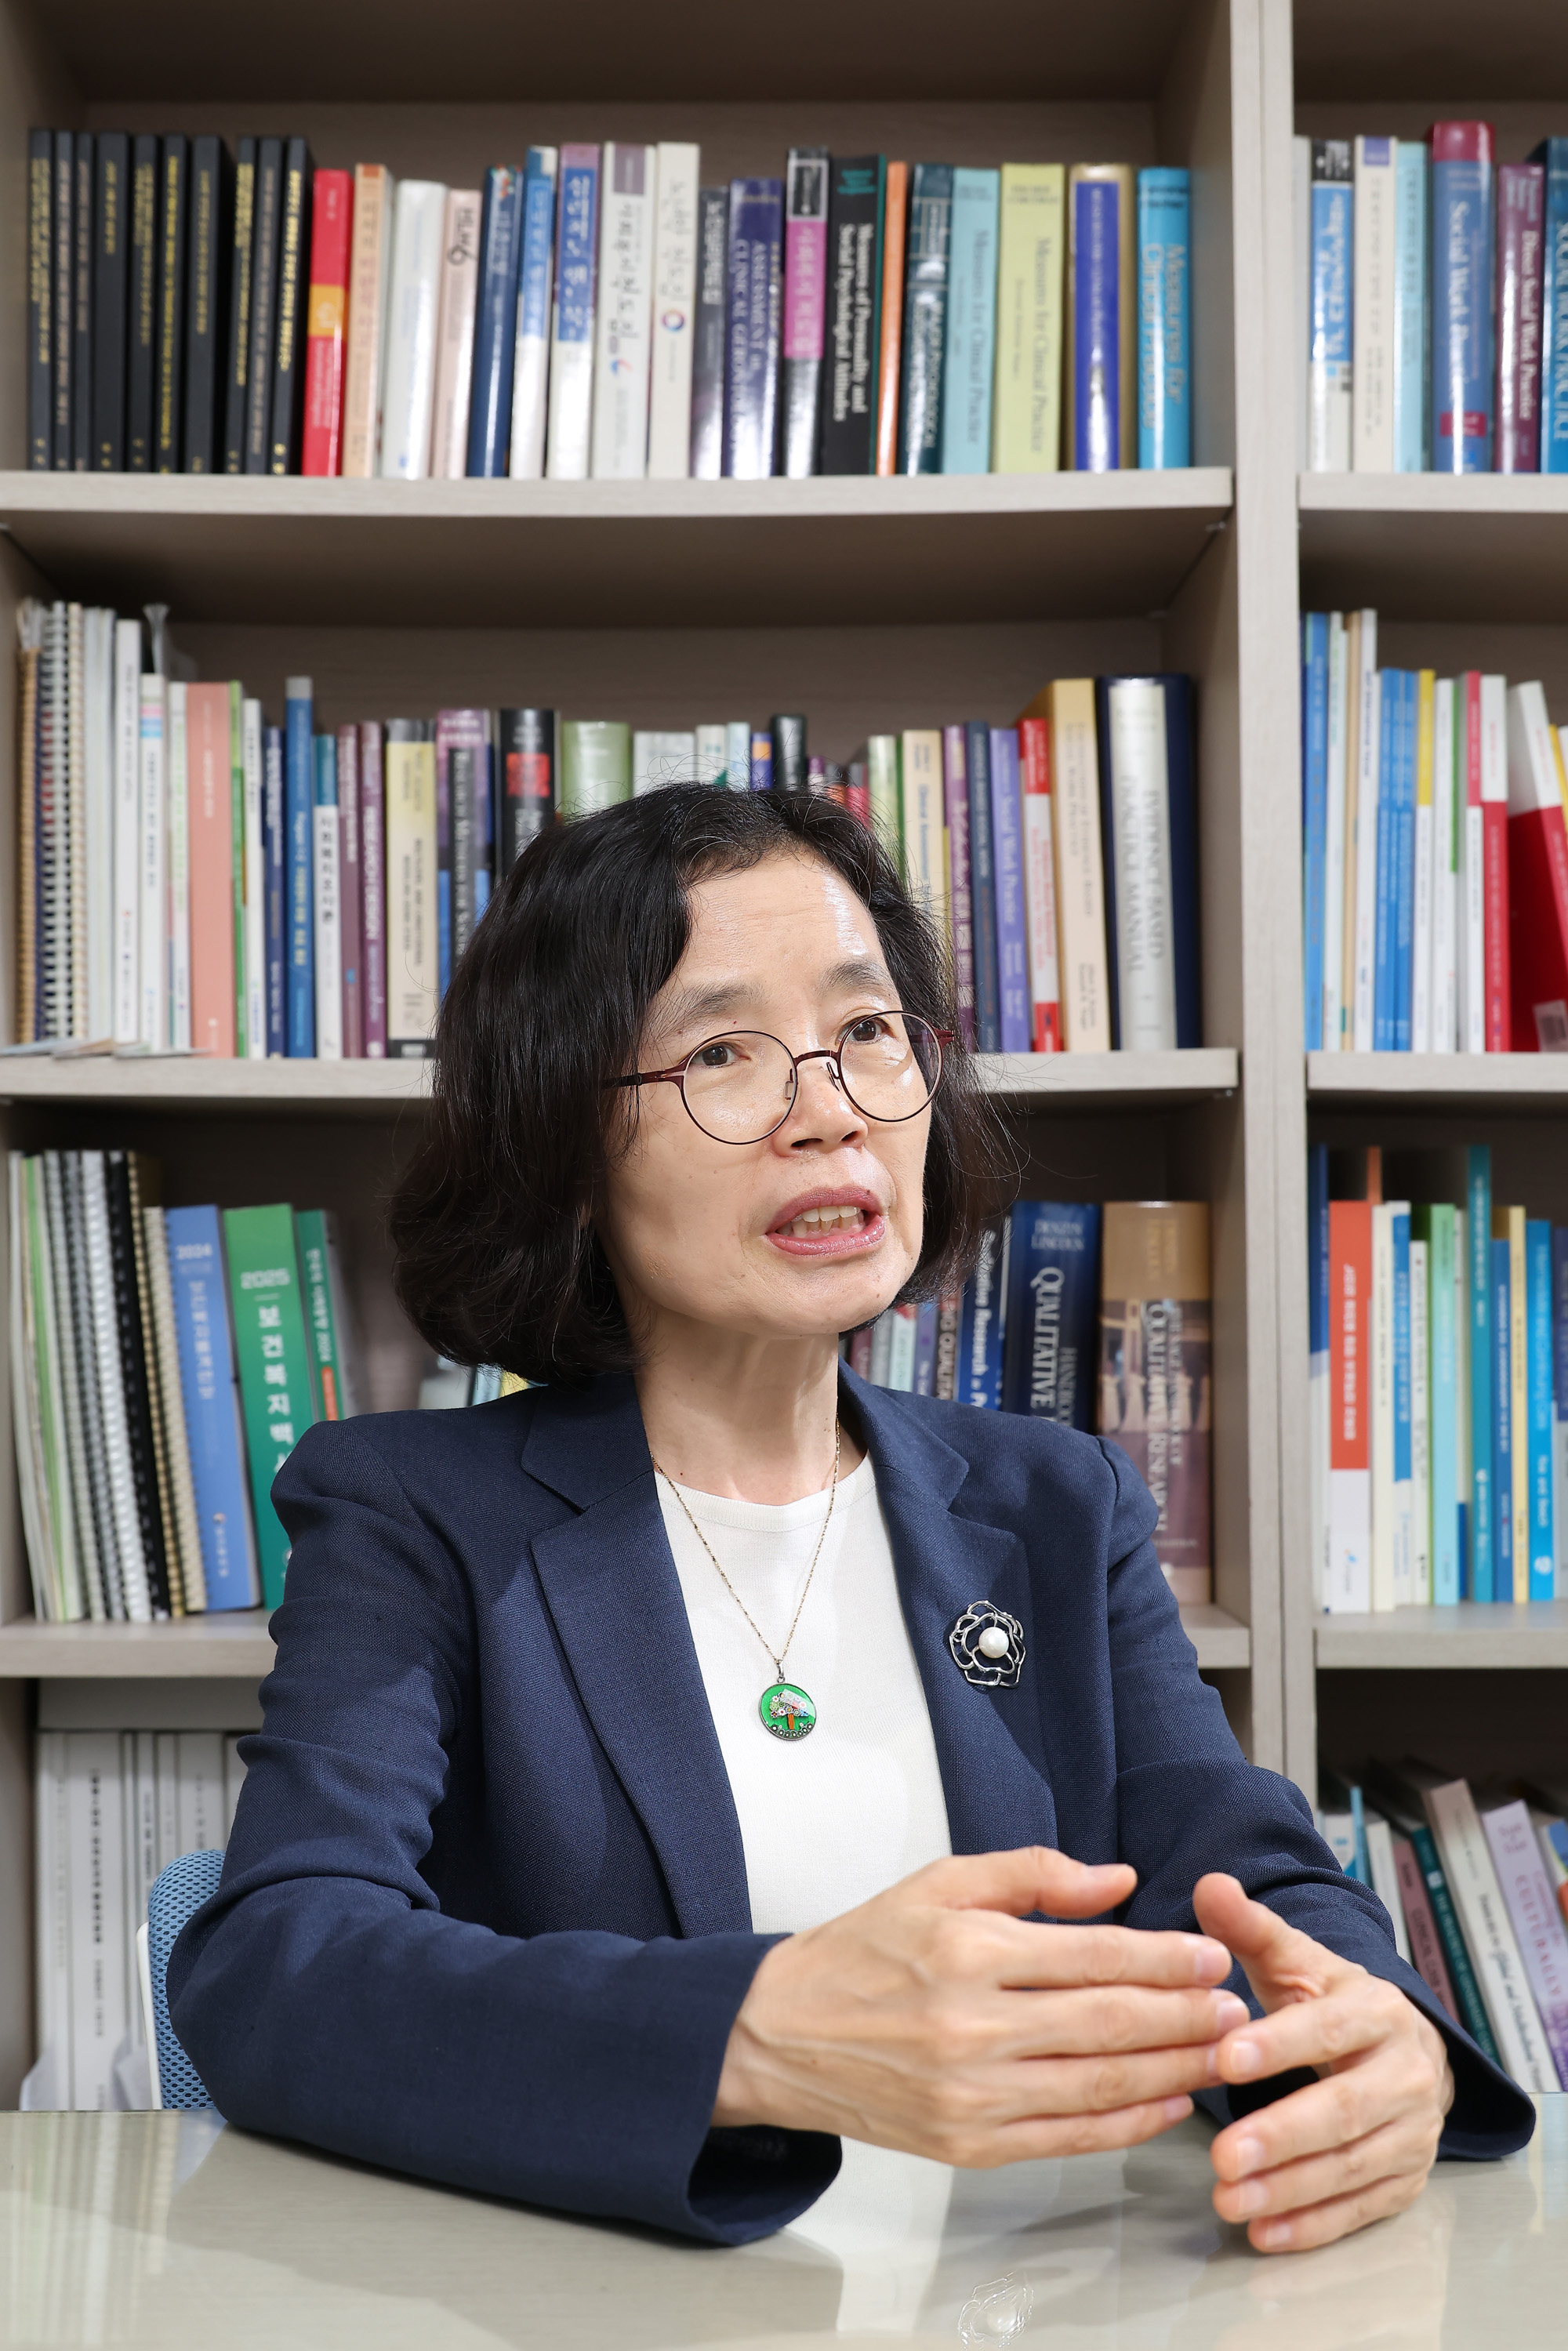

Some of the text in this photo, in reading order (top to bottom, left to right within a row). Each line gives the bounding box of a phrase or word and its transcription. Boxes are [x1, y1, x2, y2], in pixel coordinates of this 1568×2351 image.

[448, 208, 474, 265] HLM6
[1449, 201, 1469, 263] Social
[1521, 230, 1537, 276] Direct
[732, 239, 750, 318] CLINICAL
[750, 240, 768, 350] ASSESSMENT
[1142, 243, 1160, 326] Clinical
[1448, 267, 1468, 320] Work
[1519, 278, 1536, 321] Social
[833, 223, 855, 421] Social Psychological Attitudes
[851, 223, 873, 412] Measures of Personality and
[968, 230, 989, 445] Measures for Clinical Practice
[1030, 238, 1051, 452] Measures for Clinical Practice
[1166, 244, 1186, 403] Measures for
[1519, 324, 1535, 360] Work
[1519, 365, 1534, 420] Practice
[1000, 794, 1016, 832] Social
[363, 806, 379, 882] RESEARCH
[1001, 834, 1018, 873] Work
[1004, 875, 1018, 926] Practice
[1121, 775, 1144, 974] PRACTICE MANUAL
[365, 886, 379, 940] DESIGN
[176, 1243, 212, 1260] 2024
[1031, 1236, 1086, 1250] LINCOLN
[1034, 1221, 1083, 1235] DENZIN
[241, 1268, 291, 1290] 2025
[316, 1332, 332, 1362] 2024
[972, 1308, 992, 1377] Research
[1030, 1267, 1065, 1409] QUALITATIVE
[1532, 1246, 1549, 1430] Intermediate and Continuing Care
[1142, 1303, 1168, 1532] QUALITATIVE RESEARCH
[1169, 1449, 1181, 1468] OF
[1537, 1477, 1548, 1494] and
[1441, 1910, 1461, 1955] PRACTICE
[1515, 1874, 1560, 1997] CULTURALLY
